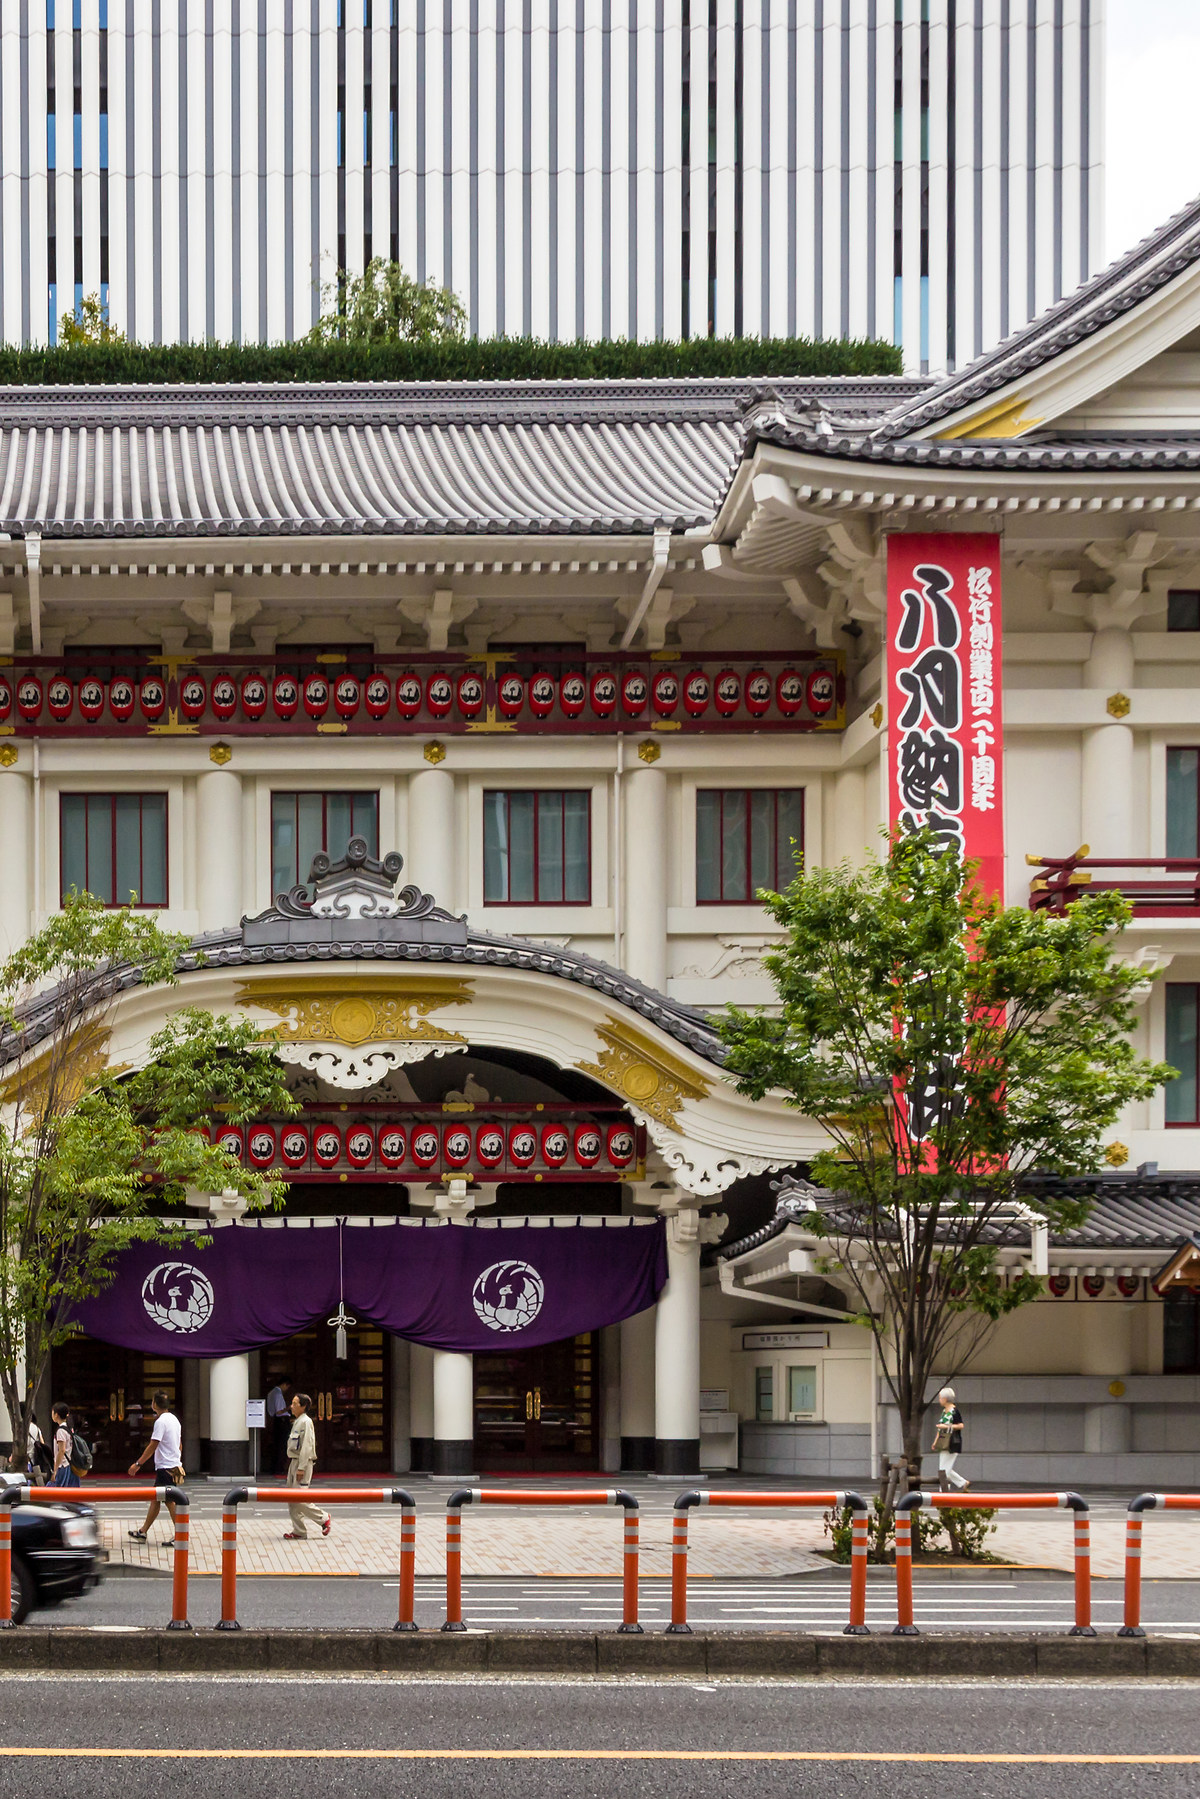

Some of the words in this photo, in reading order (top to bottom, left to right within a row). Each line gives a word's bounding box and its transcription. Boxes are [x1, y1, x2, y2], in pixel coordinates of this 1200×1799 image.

[967, 566, 995, 812] 松竹創業百二十周年
